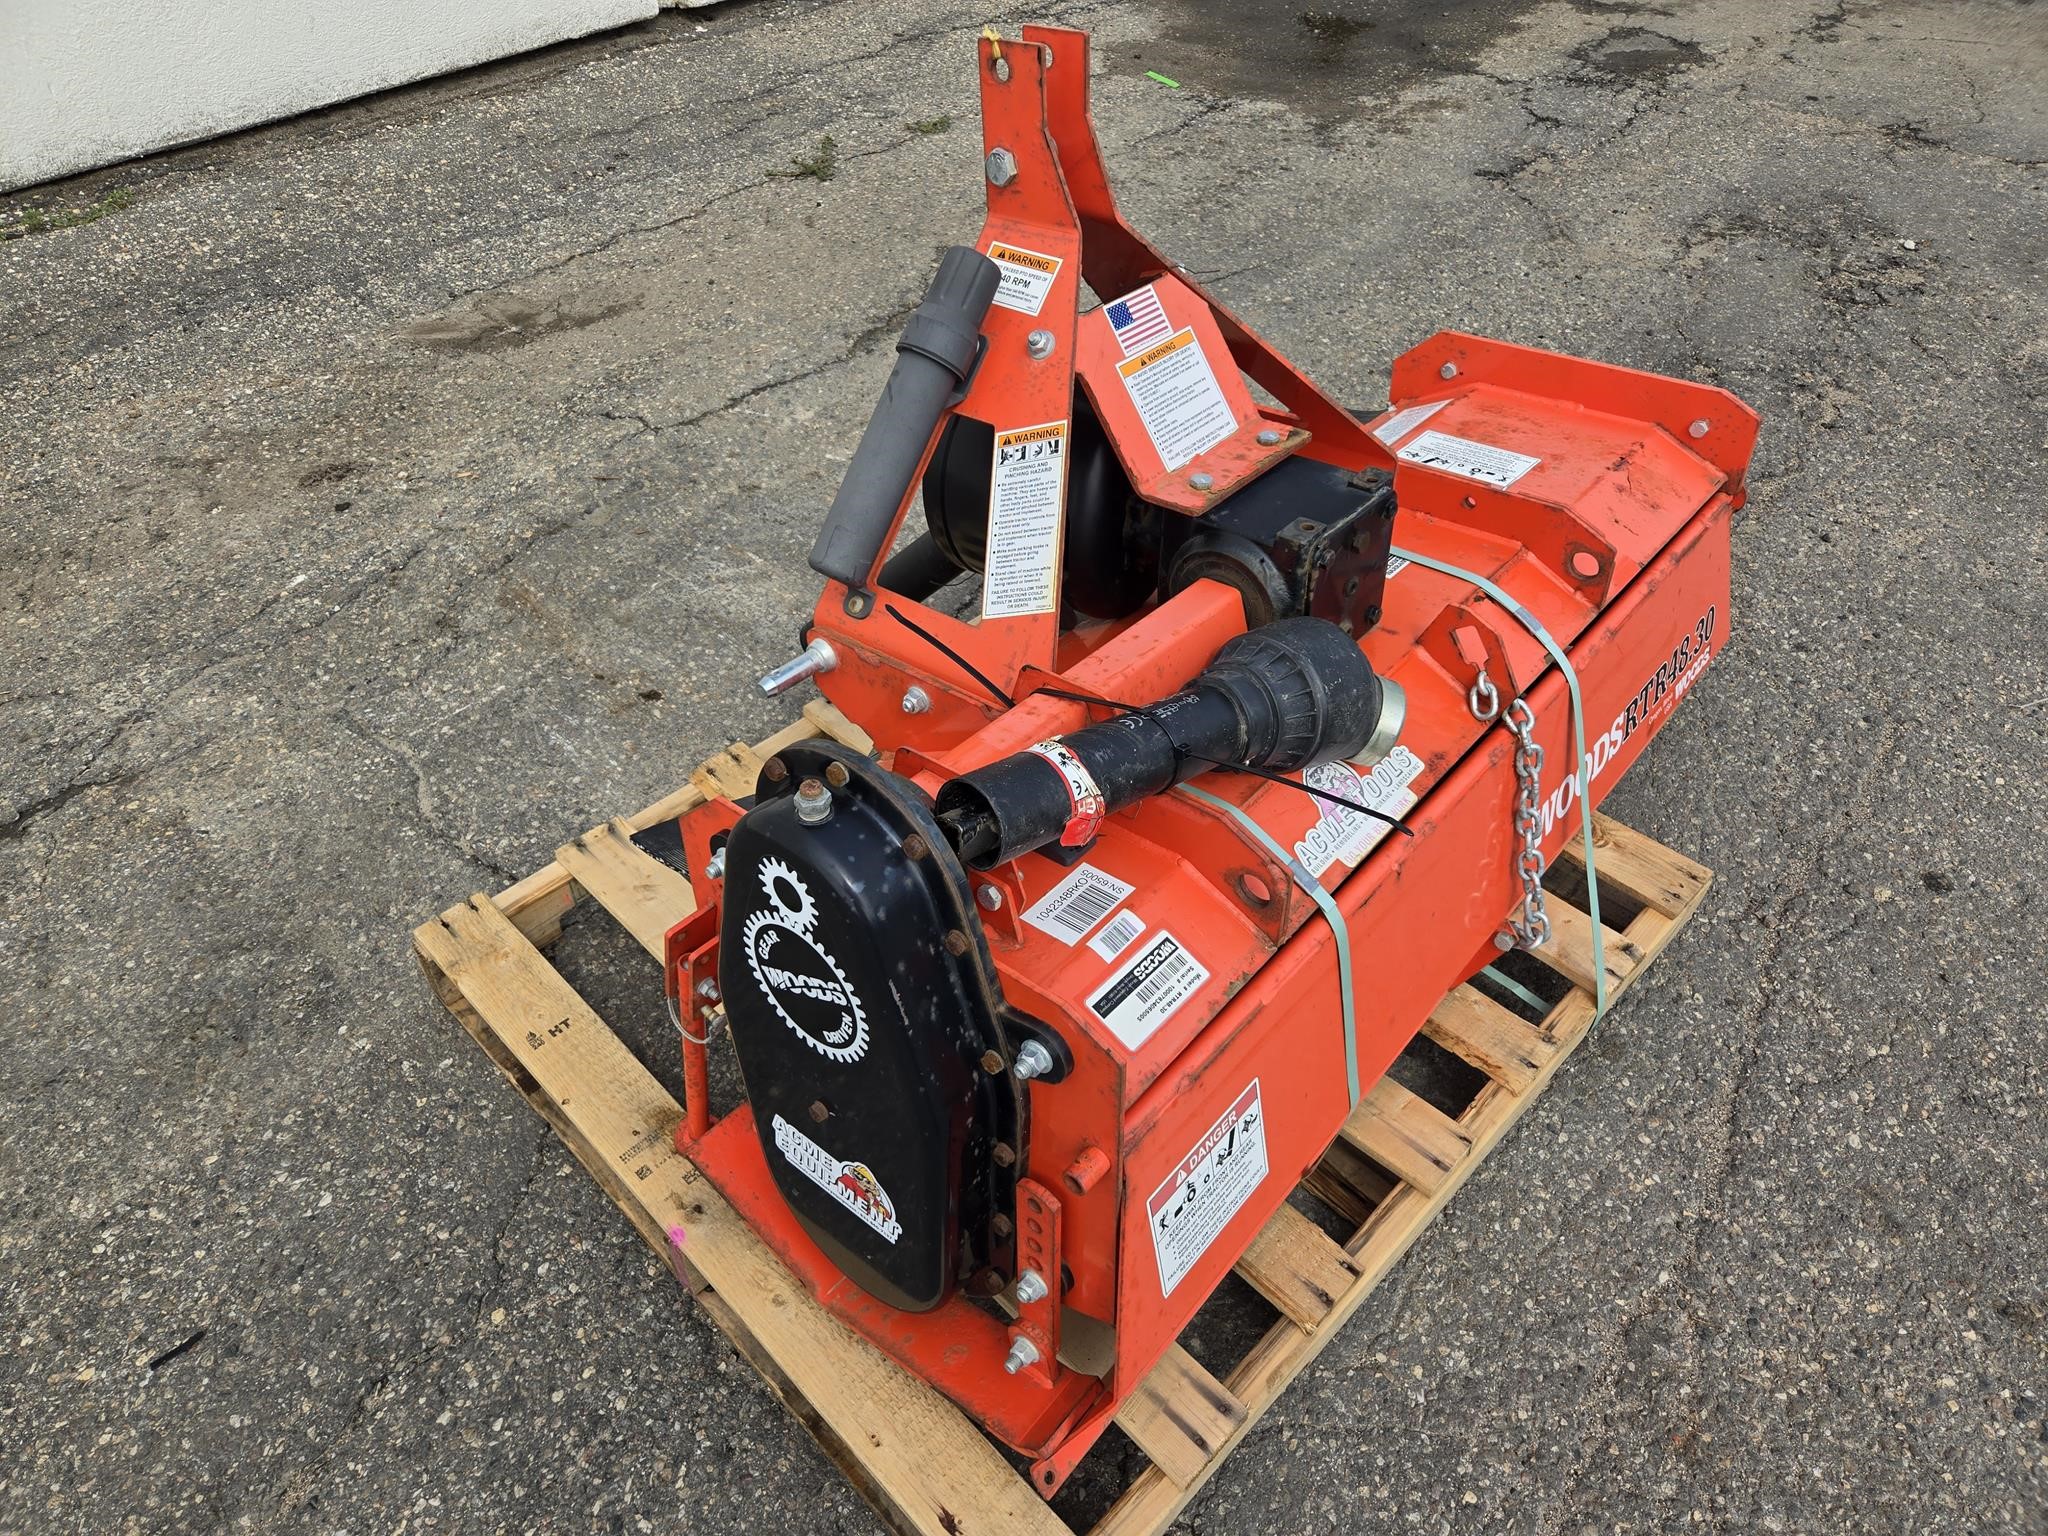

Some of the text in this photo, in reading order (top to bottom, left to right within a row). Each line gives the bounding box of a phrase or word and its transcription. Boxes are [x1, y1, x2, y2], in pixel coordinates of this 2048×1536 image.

[1006, 251, 1050, 270] WARNING
[999, 273, 1031, 288] 40 RPM
[1145, 341, 1176, 362] WARNING
[1014, 427, 1059, 443] WARNING
[1004, 466, 1052, 478] PINCHING HAZARD
[1623, 604, 1716, 743] RTR48.30
[1675, 647, 1711, 699] WOODS
[1293, 745, 1414, 867] ACME TOOLS
[1333, 823, 1361, 851] REMODELING
[1081, 869, 1125, 895] SN:65005
[758, 930, 781, 960] GEAR
[1131, 939, 1176, 981] WOODS
[1179, 965, 1194, 980] Serial
[761, 964, 850, 1007] WOODS
[1185, 972, 1202, 988] Model
[1158, 990, 1183, 1014] RTR48.30
[548, 1017, 571, 1038] HT
[822, 1012, 853, 1045] DRIVEN
[773, 1117, 833, 1171] ACME
[1189, 1108, 1236, 1171] DANGER
[778, 1135, 900, 1236] EQUIPMENT
